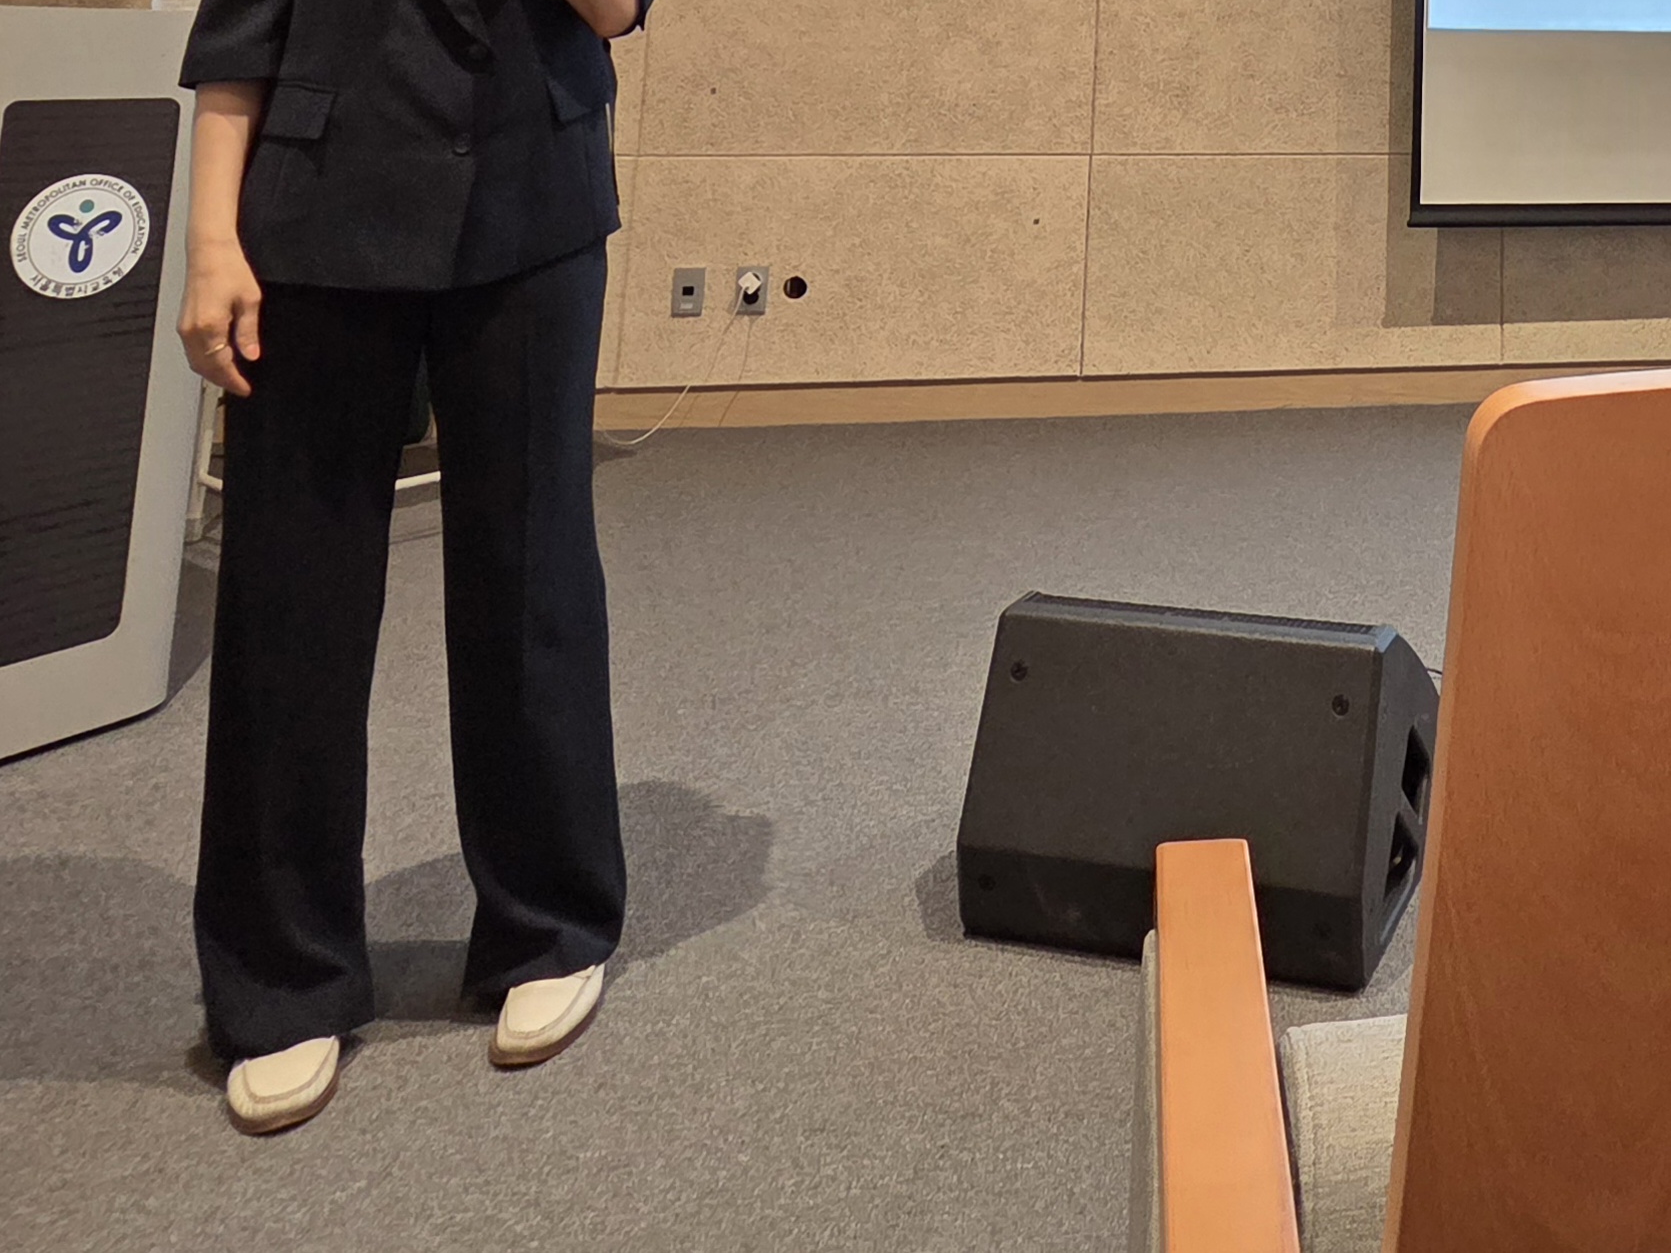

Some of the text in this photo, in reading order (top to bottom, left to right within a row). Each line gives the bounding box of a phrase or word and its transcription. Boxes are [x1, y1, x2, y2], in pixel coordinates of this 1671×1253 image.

[21, 179, 86, 230] METROPOLITAN
[90, 178, 124, 192] OFFICE
[122, 190, 136, 201] OF
